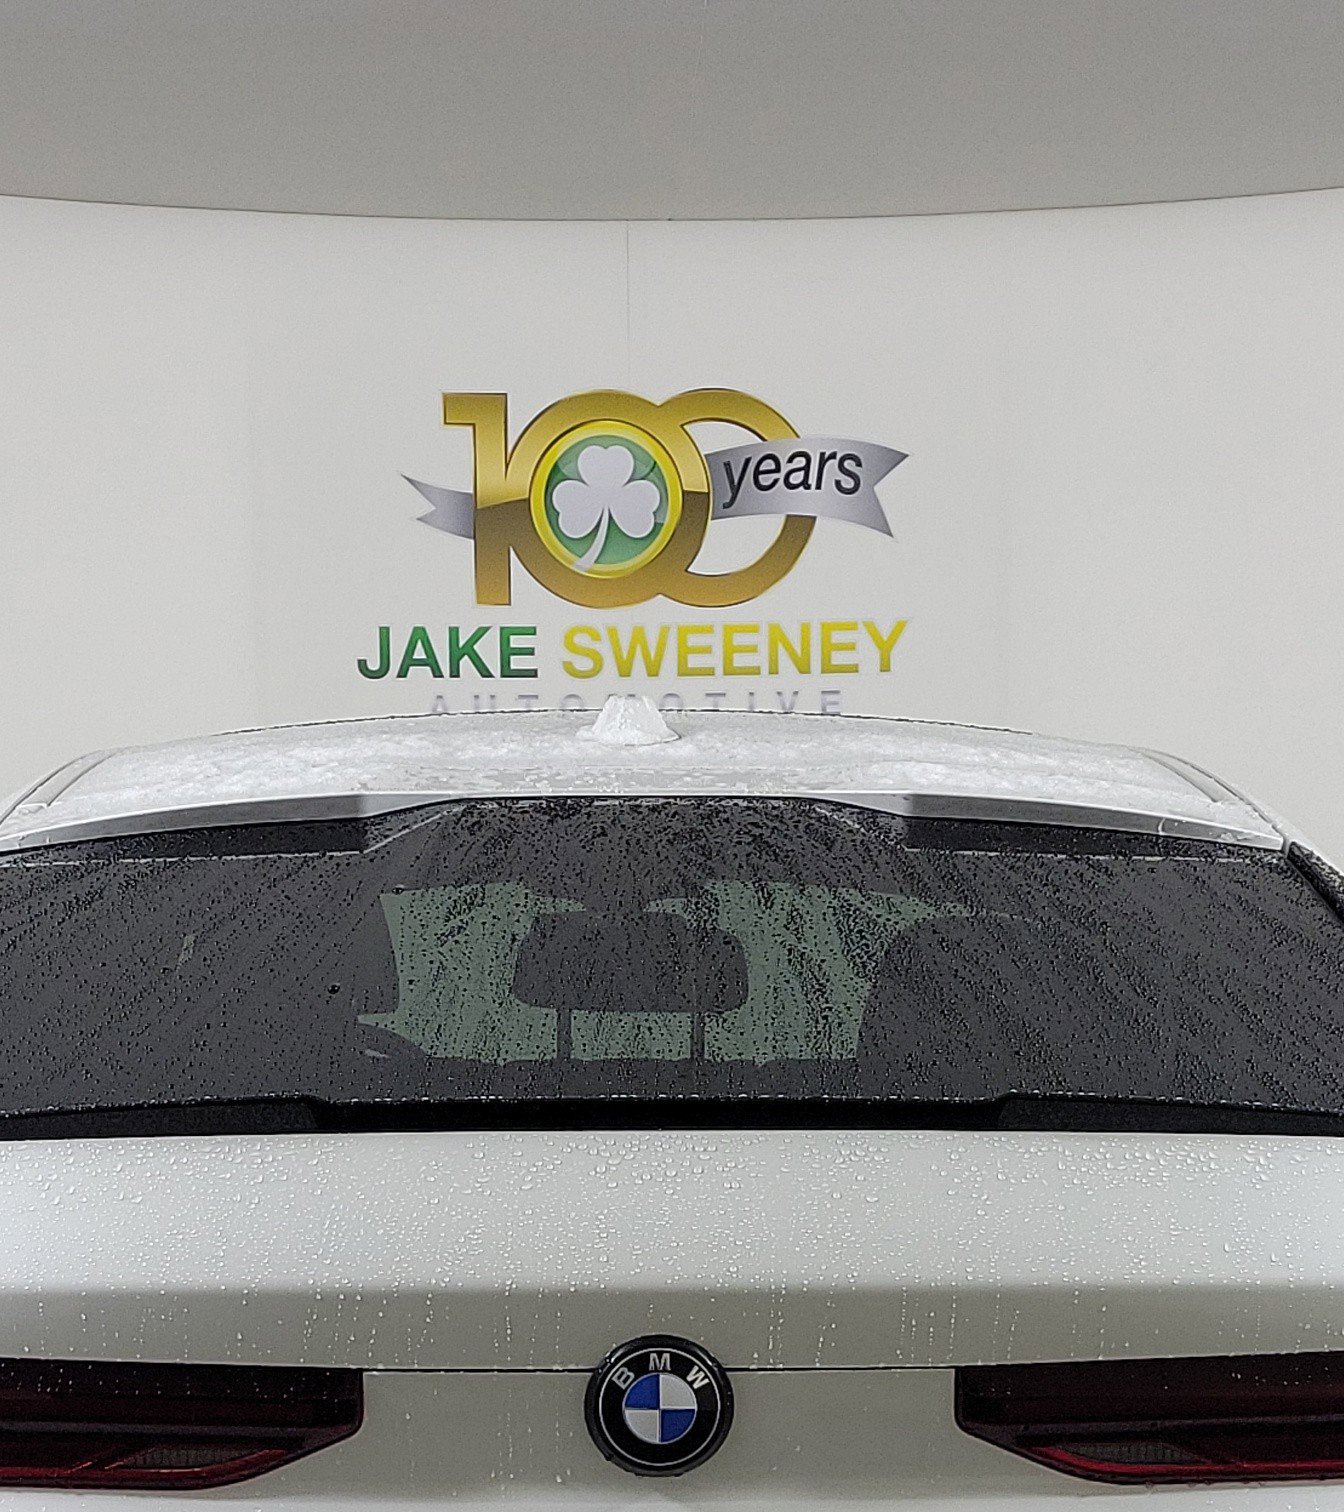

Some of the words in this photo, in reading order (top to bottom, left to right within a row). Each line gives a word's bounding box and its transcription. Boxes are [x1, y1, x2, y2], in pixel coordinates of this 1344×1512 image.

[441, 387, 818, 609] 100
[721, 446, 864, 510] years
[356, 625, 539, 679] JAKE
[561, 618, 909, 678] SWEENEY
[431, 689, 842, 715] AUTOOTIVE
[611, 1352, 710, 1390] BMW
